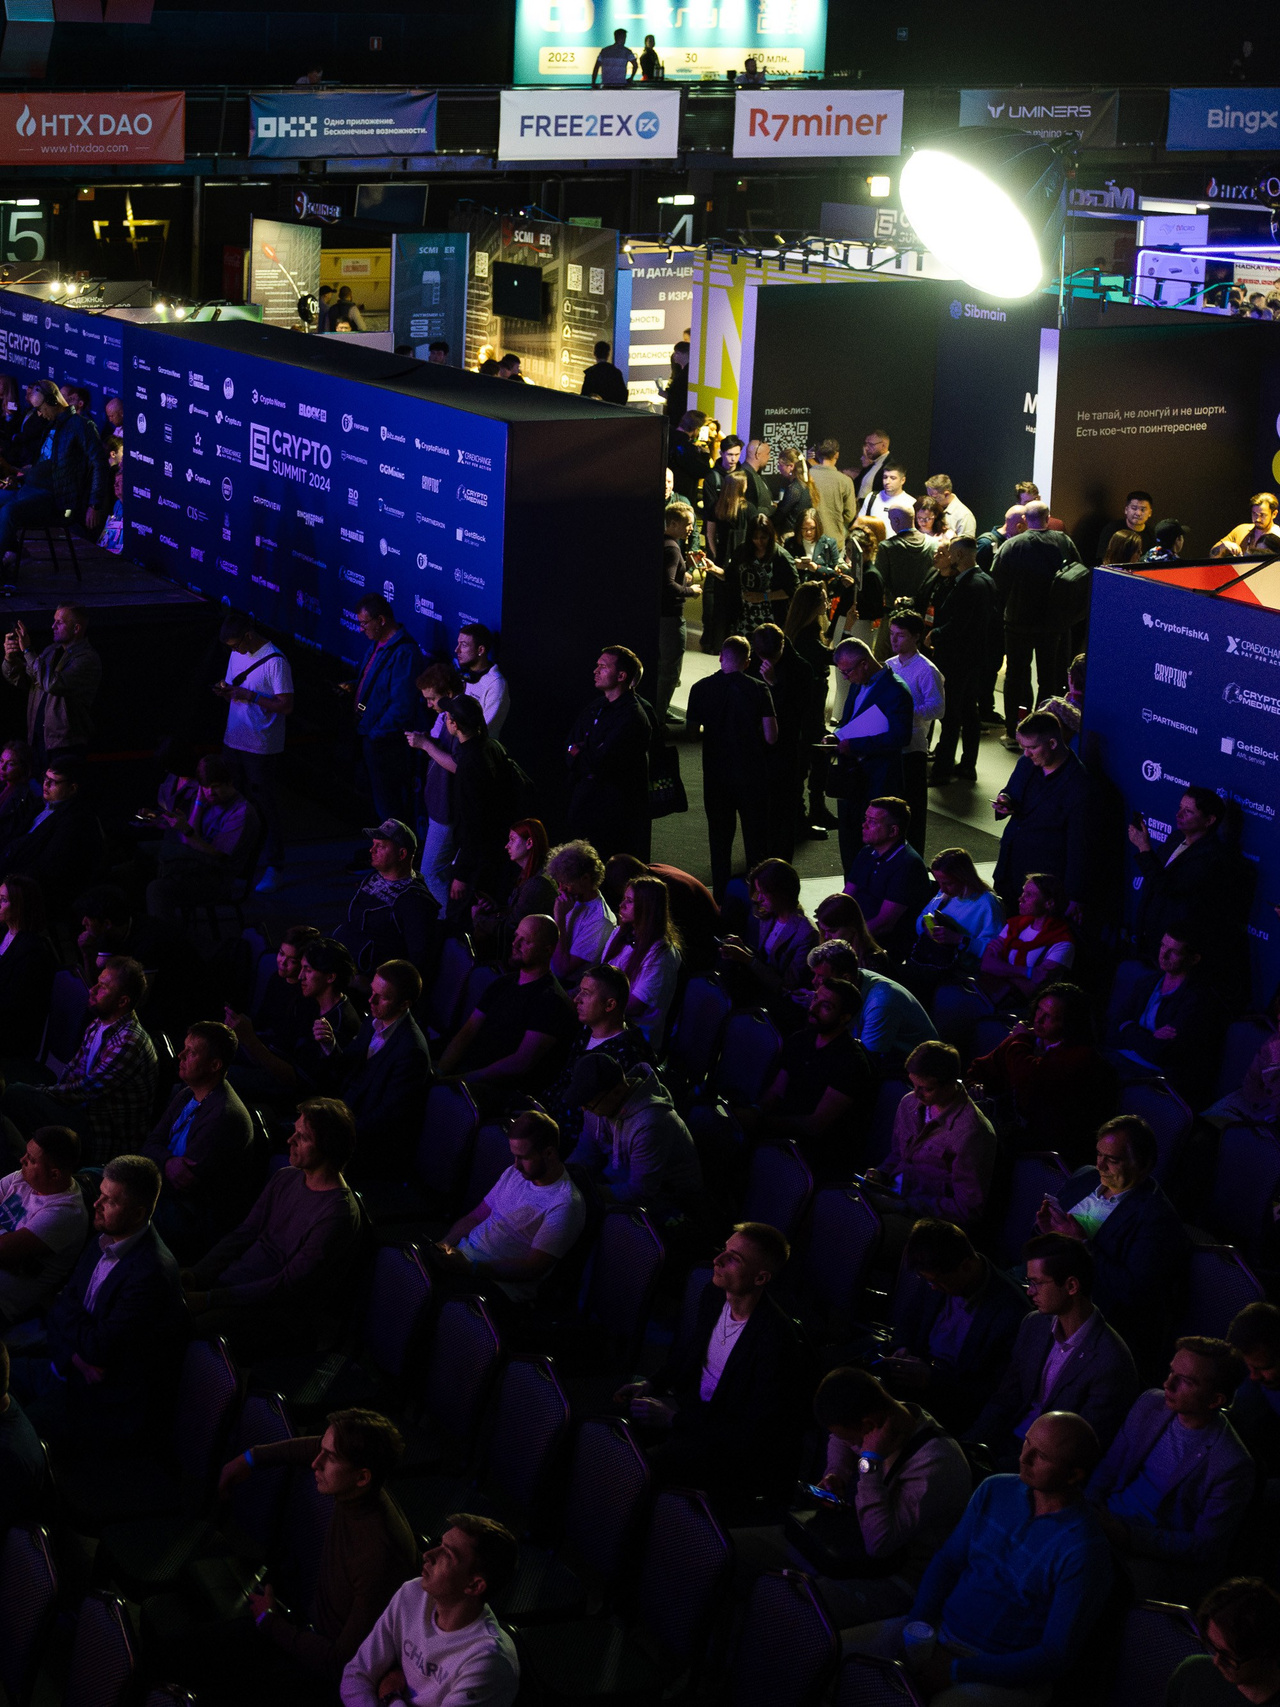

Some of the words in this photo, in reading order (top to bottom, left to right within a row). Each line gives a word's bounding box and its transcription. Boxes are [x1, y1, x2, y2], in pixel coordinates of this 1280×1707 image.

[548, 52, 576, 62] 2023
[685, 53, 698, 63] 30
[1008, 105, 1091, 118] UMINERS
[41, 114, 94, 136] HTX
[99, 113, 153, 136] DAO
[258, 116, 317, 138] OKX
[324, 118, 345, 126] Одно
[346, 117, 395, 126] приложение.
[520, 114, 633, 137] FREE2EX
[749, 105, 888, 142] R7miner
[324, 128, 375, 136] Бесконечные
[376, 127, 428, 135] возможности.
[41, 143, 129, 153] www.htxdao.com
[7, 211, 46, 261] 5
[632, 267, 644, 278] ТИ
[668, 291, 693, 301] ИЗРА
[630, 315, 659, 323] ЬНОСТЬ
[964, 303, 1007, 322] Sibmain
[8, 332, 40, 356] CRYPTO
[765, 407, 811, 415] ПРАЙС-ЛИСТ:
[1077, 410, 1090, 421] Не
[1092, 409, 1122, 421] тапай,
[1124, 411, 1135, 420] не
[1137, 407, 1170, 419] лонгуй
[1172, 408, 1179, 416] и
[1180, 407, 1192, 416] не
[1194, 405, 1227, 416] шорти.
[1076, 426, 1098, 437] Есть
[1099, 425, 1138, 436] кое-что
[1139, 422, 1208, 434] поинтереснее
[272, 430, 332, 470] CRYPTO
[272, 460, 308, 484] SUMMIT
[309, 471, 331, 492] 2024
[1155, 619, 1210, 642] CryptoFishKA
[1241, 651, 1253, 659] PAY
[1255, 654, 1267, 663] PER
[1153, 714, 1198, 735] PARTNERKIN
[1237, 740, 1279, 761] GetBlock
[1163, 773, 1191, 787] FINFORUM
[1148, 817, 1172, 834] CRYPTO
